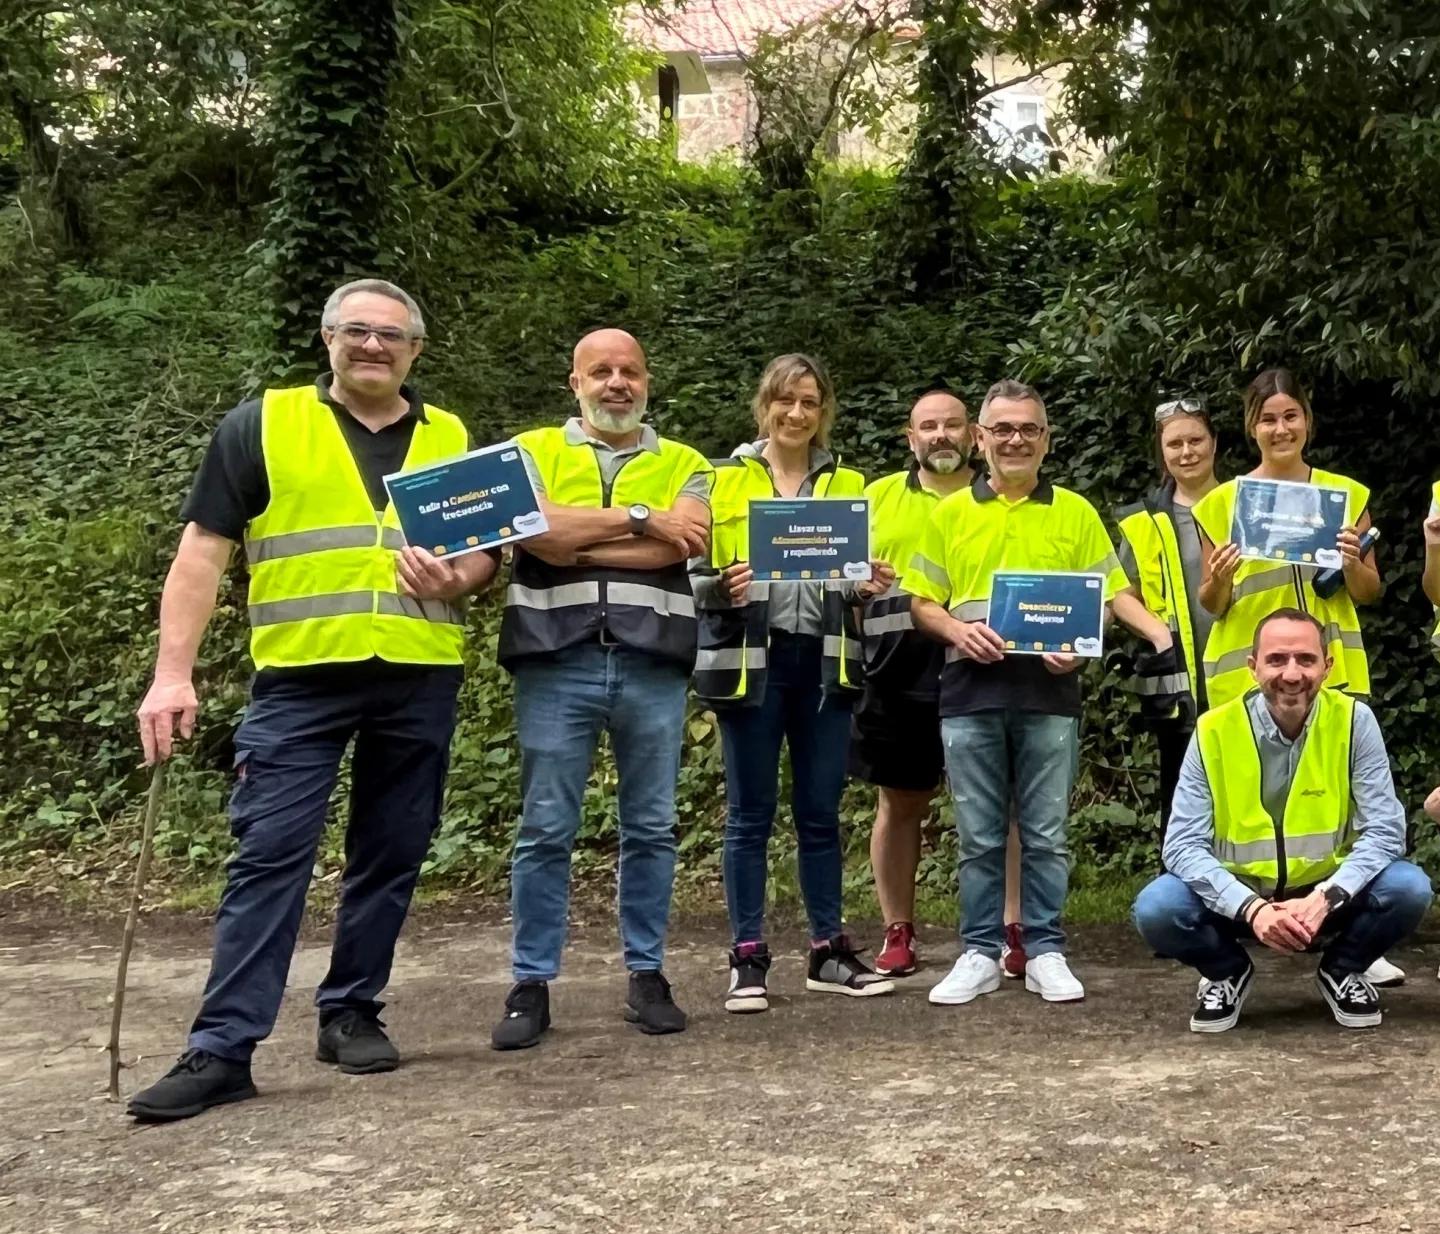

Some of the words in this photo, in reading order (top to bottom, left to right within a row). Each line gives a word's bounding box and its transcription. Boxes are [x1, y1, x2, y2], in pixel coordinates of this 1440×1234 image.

[450, 489, 489, 506] Caminar
[490, 484, 510, 494] con
[442, 501, 494, 520] frecuencia
[784, 550, 788, 558] y
[1067, 606, 1072, 614] y
